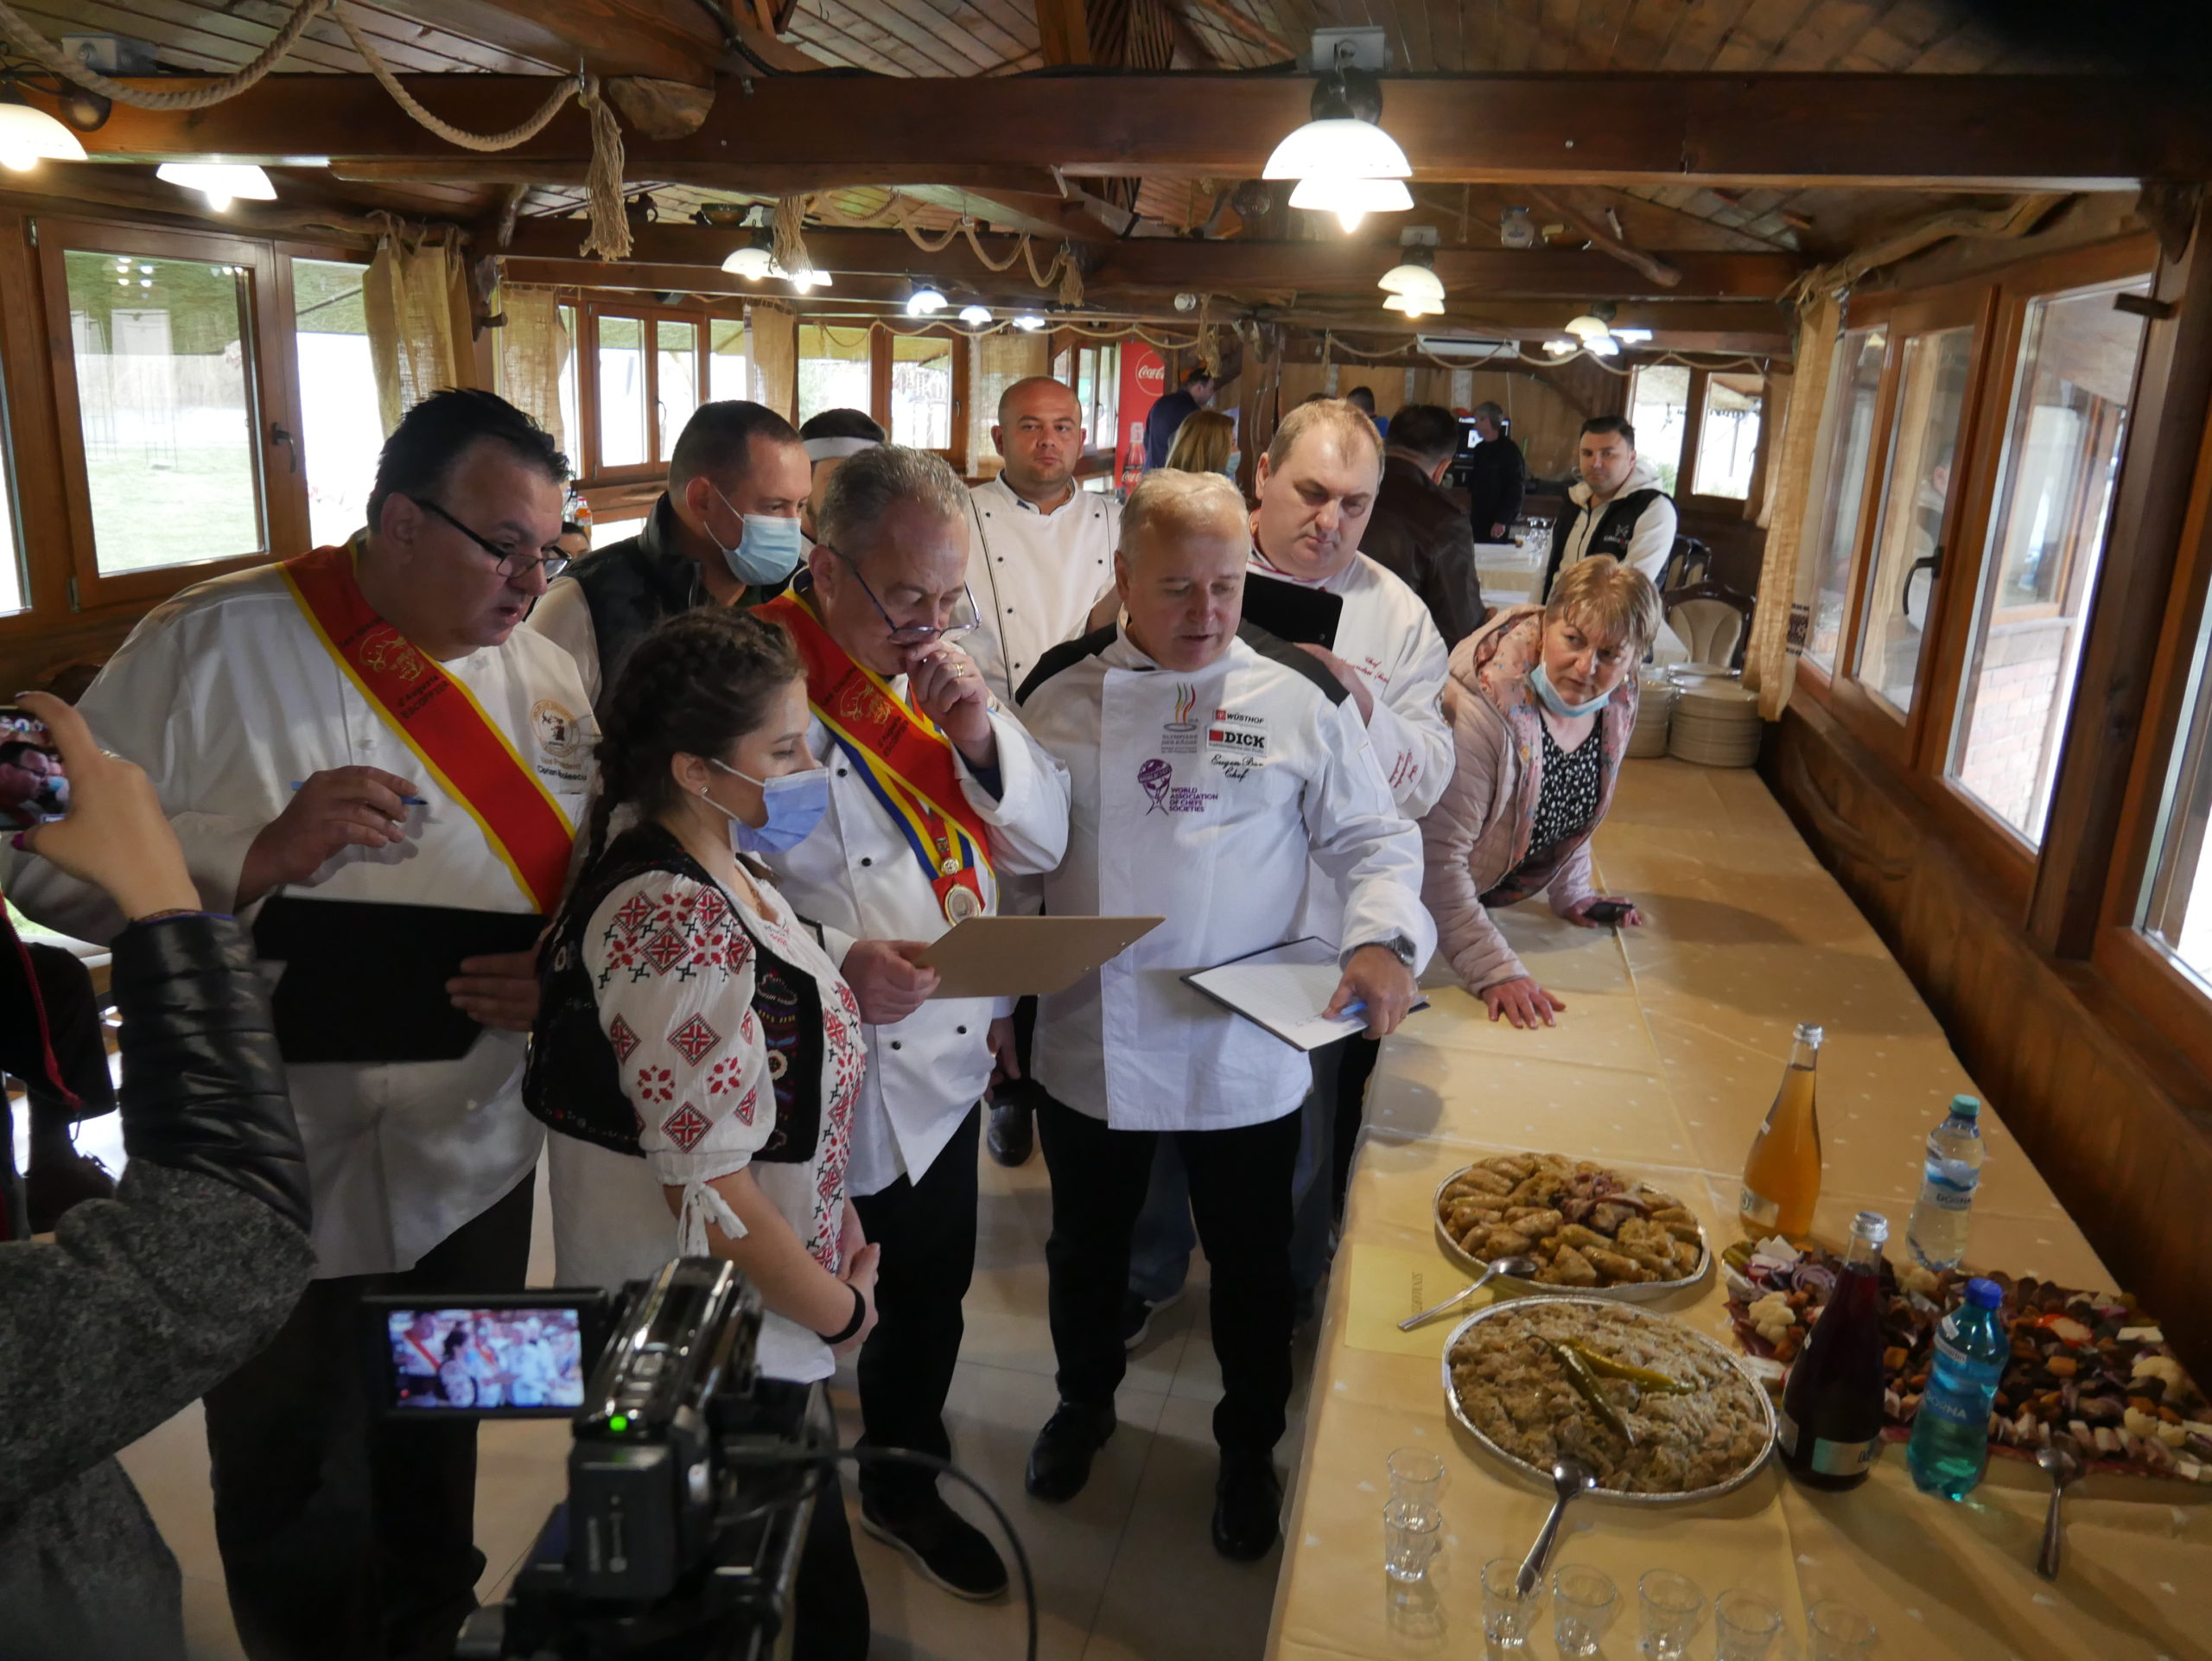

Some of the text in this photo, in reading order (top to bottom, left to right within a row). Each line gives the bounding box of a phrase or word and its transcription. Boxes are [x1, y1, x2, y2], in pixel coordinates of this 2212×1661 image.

[1227, 711, 1265, 724] WÜSTHOF
[1224, 731, 1265, 748] DICK
[1224, 767, 1249, 783] Chef
